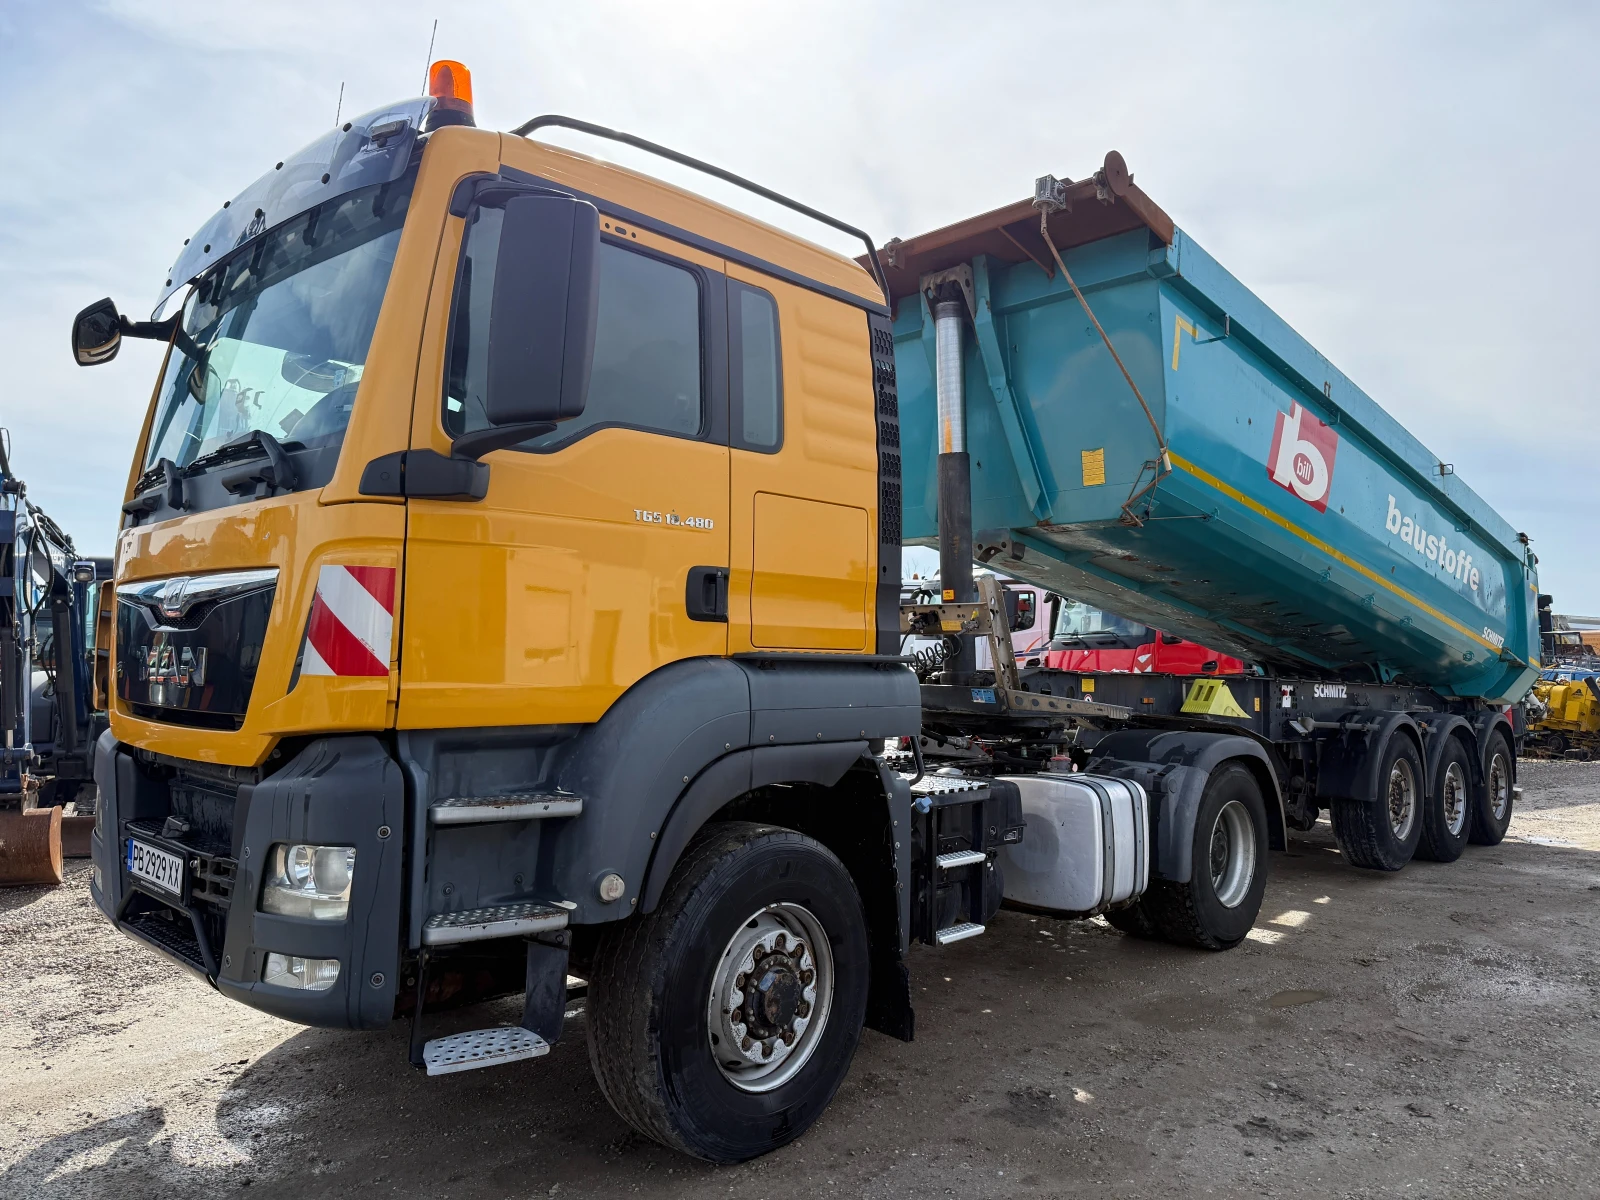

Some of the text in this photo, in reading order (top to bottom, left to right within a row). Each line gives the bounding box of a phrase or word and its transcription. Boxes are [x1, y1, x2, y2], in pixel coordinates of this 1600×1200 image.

[1296, 457, 1312, 482] bill
[1385, 493, 1480, 592] baustoffe
[1481, 626, 1505, 649] SCHMITZ
[139, 645, 208, 688] MAN
[1313, 683, 1348, 699] SCHMITZ
